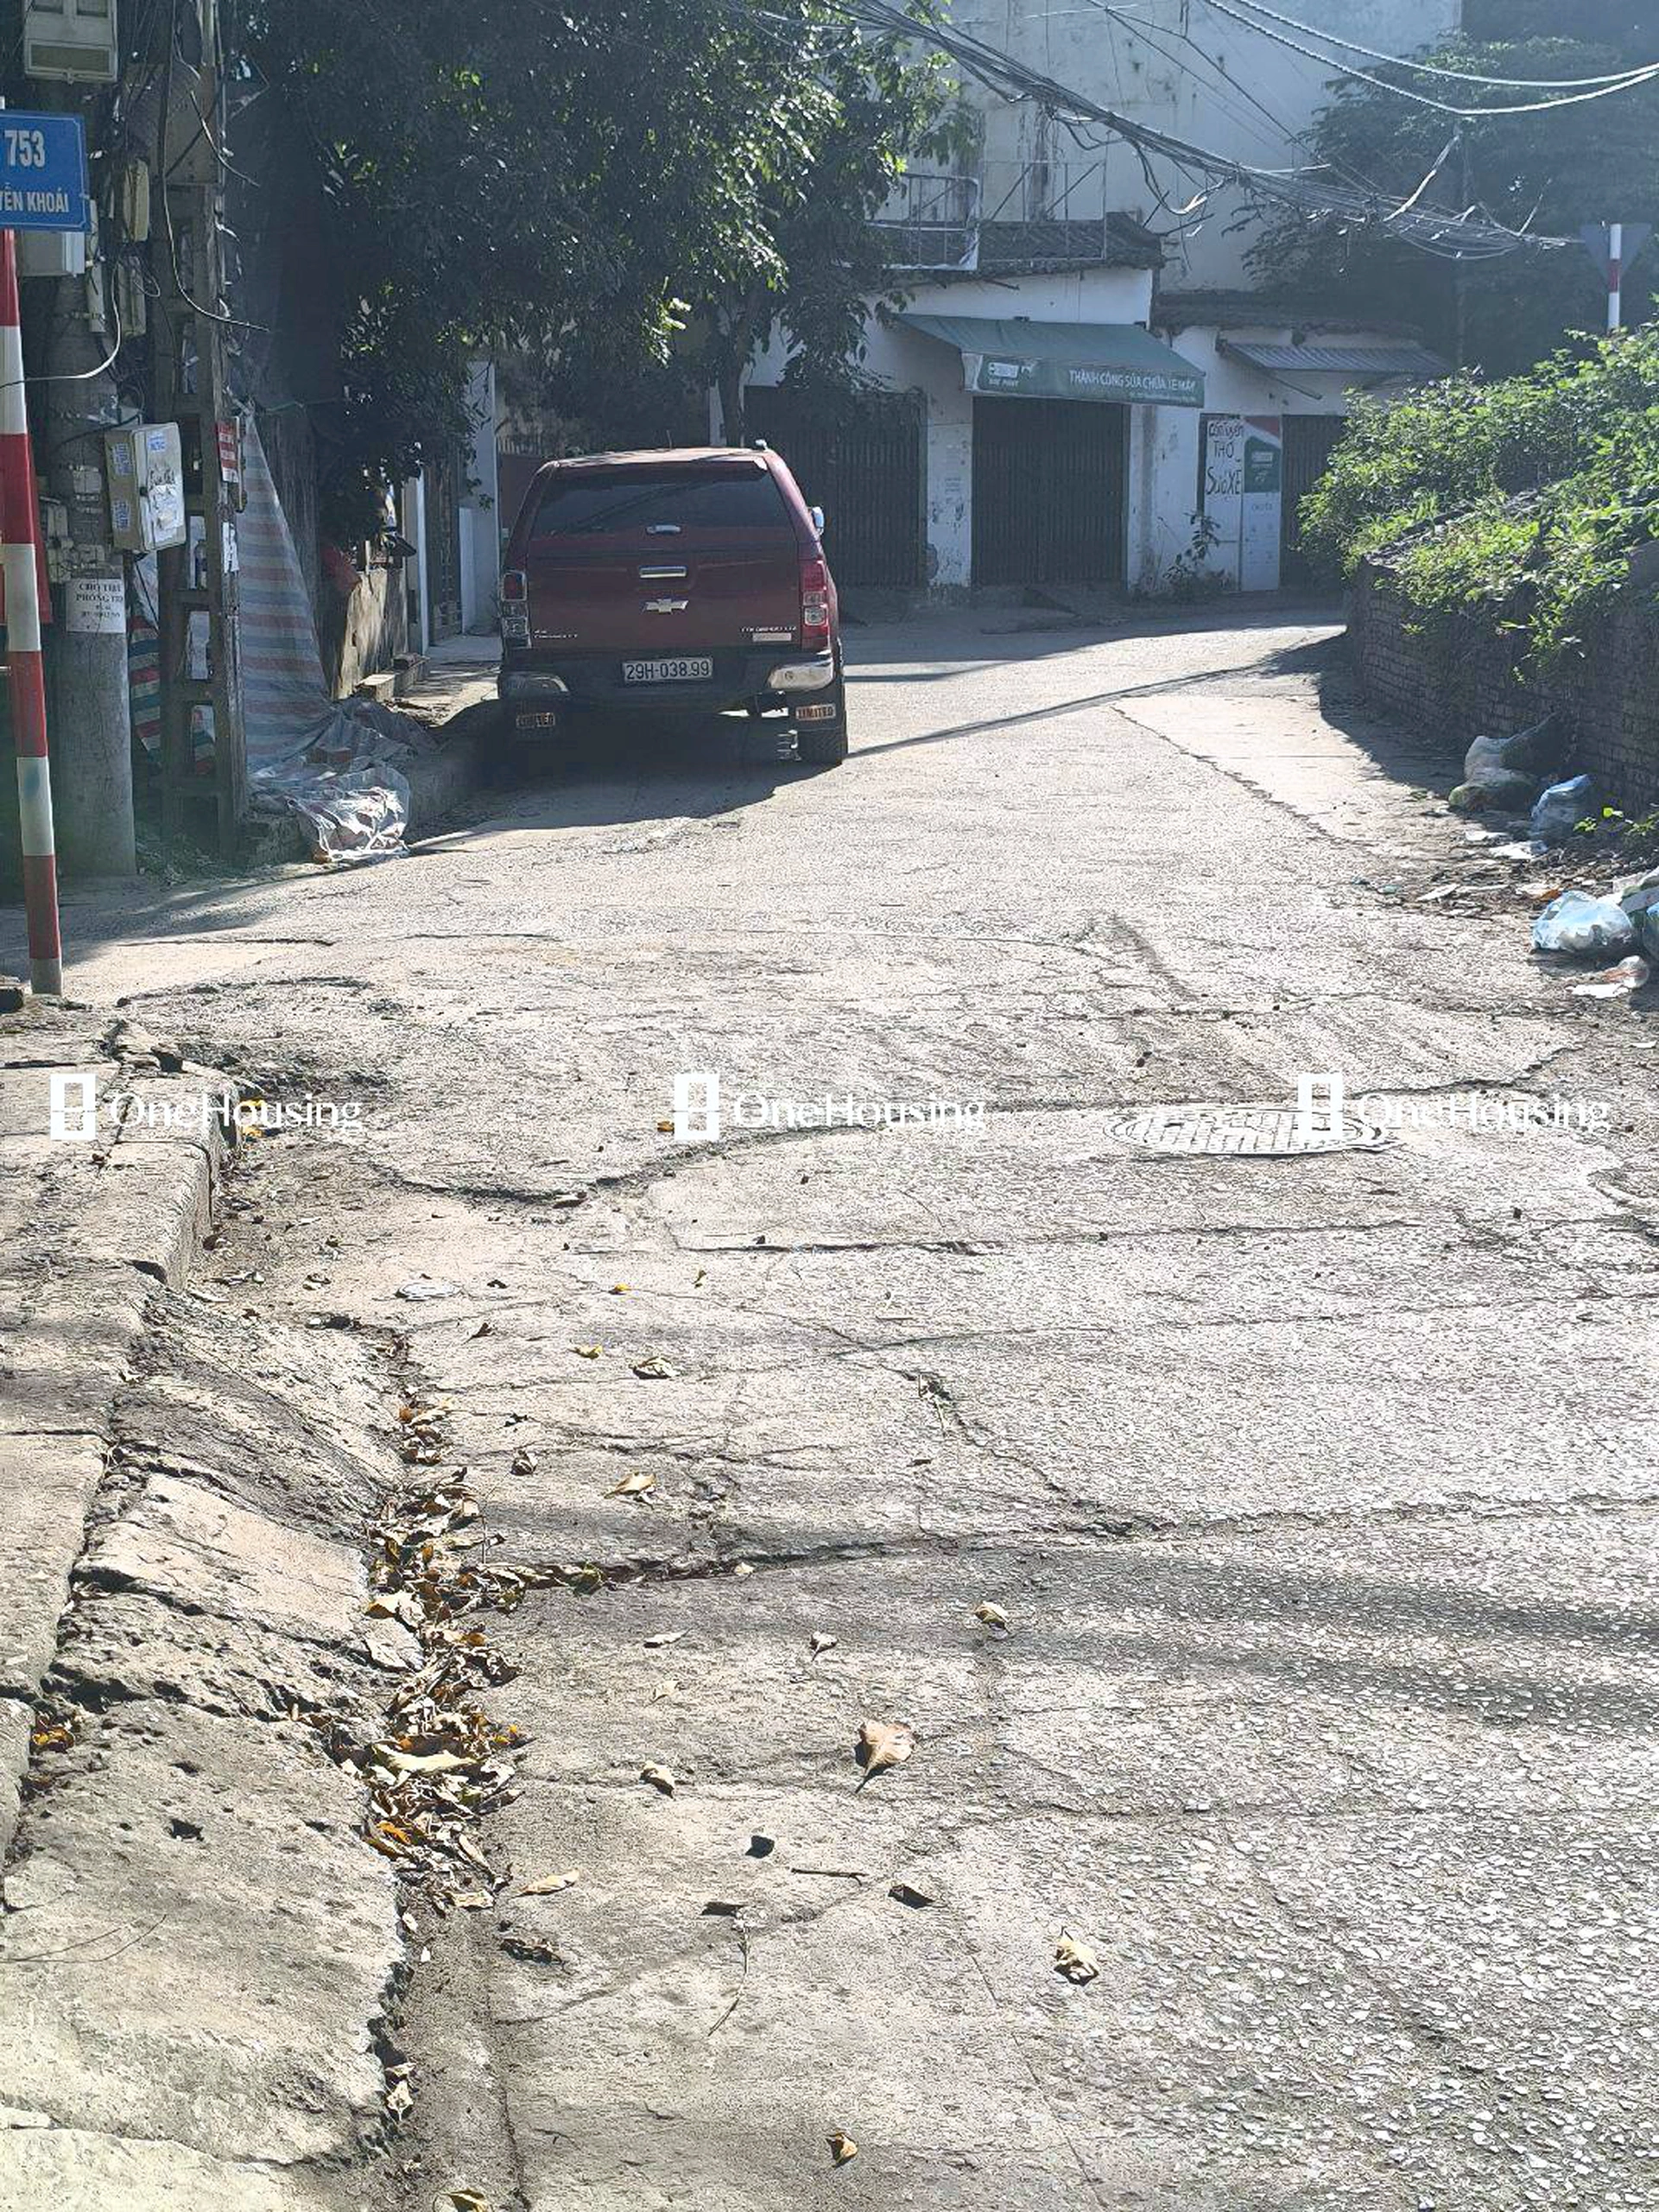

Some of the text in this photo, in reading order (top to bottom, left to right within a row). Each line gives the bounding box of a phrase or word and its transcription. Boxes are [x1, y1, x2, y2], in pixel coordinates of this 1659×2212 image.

[4, 130, 46, 168] 753
[26, 187, 69, 212] KHOÁI
[626, 660, 709, 680] 29H-038.99
[797, 706, 835, 719] LIMITED
